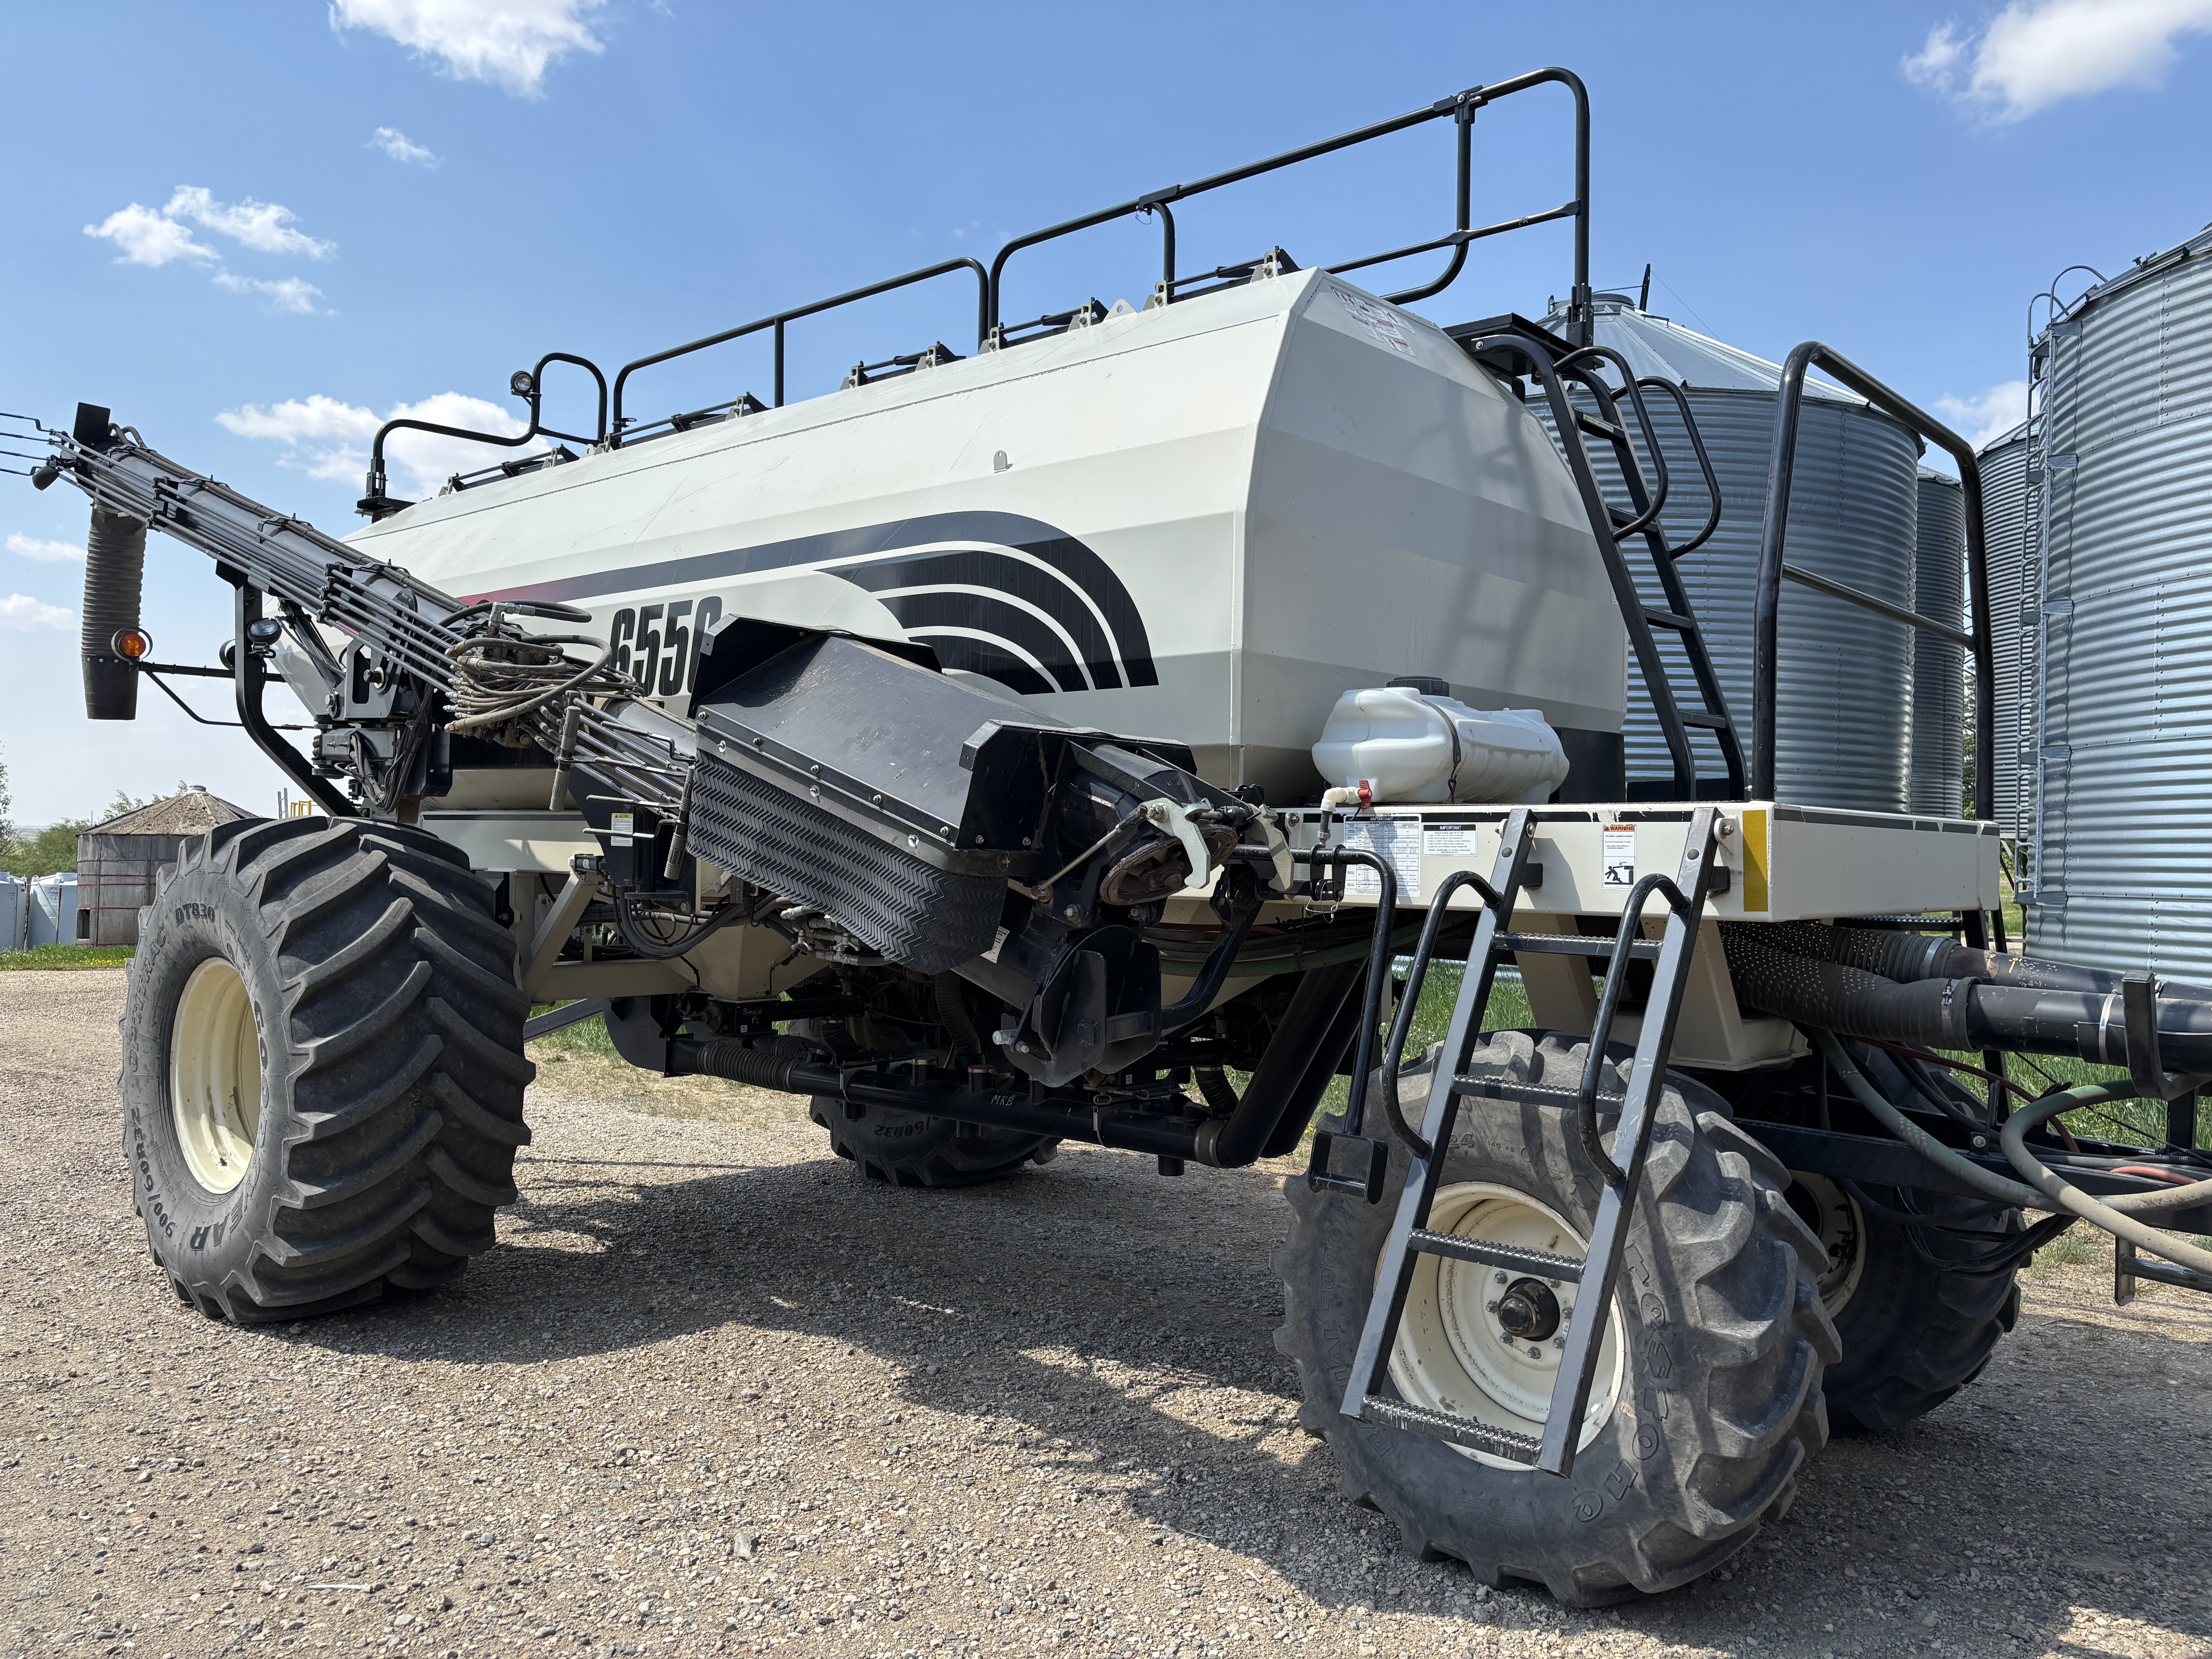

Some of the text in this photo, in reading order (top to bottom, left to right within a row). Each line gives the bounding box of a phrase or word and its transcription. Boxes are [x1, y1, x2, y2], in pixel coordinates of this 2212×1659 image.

[175, 903, 215, 926] DT830
[743, 1006, 762, 1017] Single
[991, 1094, 1014, 1106] MRB
[132, 1106, 176, 1238] 900/60R32
[1321, 1228, 1343, 1310] 9000
